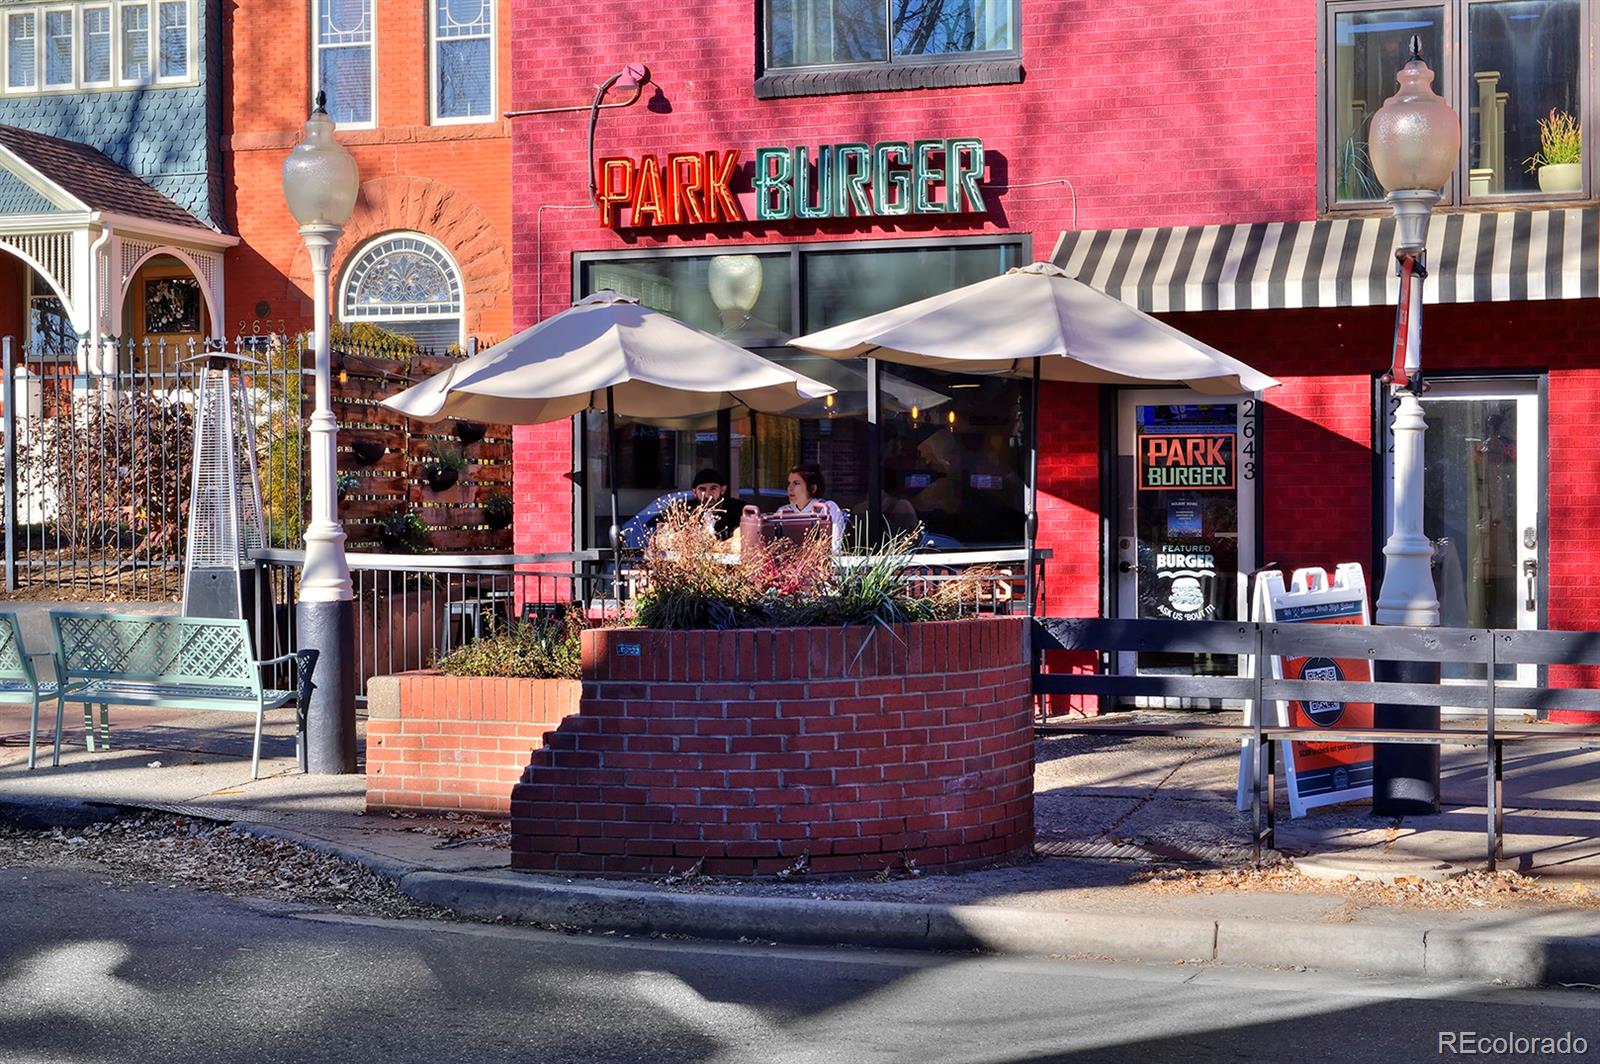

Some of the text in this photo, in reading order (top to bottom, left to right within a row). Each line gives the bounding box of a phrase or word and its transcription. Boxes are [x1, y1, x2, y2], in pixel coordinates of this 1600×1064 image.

[596, 138, 987, 229] PARK BURGER
[239, 320, 286, 334] 2653
[1243, 400, 1256, 480] 2643
[1148, 438, 1226, 466] PARK
[1148, 466, 1227, 486] BURGER
[1157, 554, 1215, 570] BURGER
[1157, 604, 1173, 618] ASK
[1172, 611, 1183, 621] US
